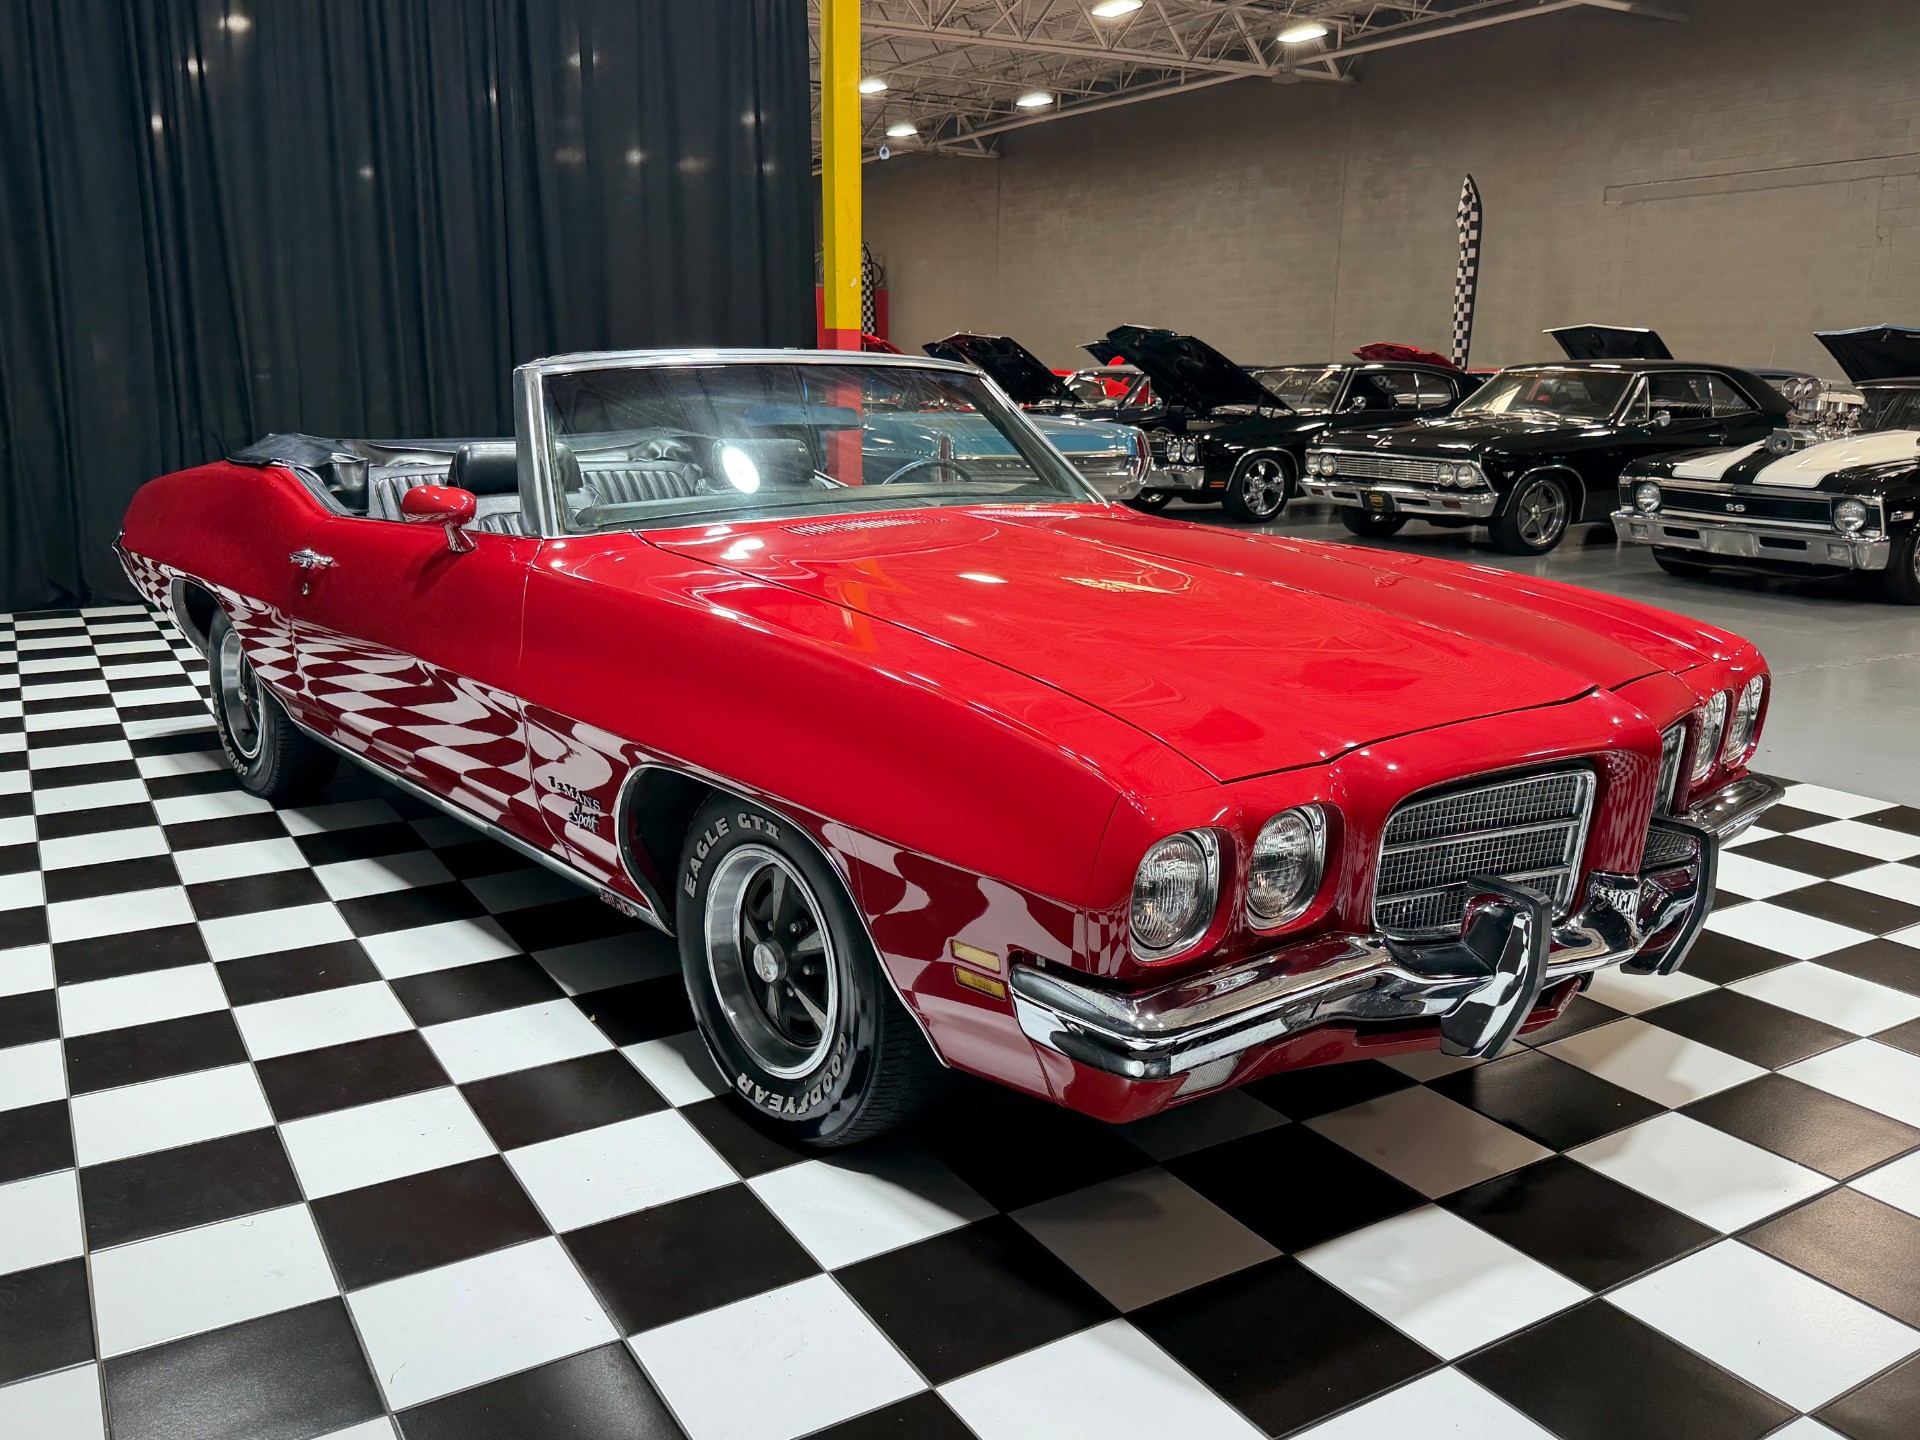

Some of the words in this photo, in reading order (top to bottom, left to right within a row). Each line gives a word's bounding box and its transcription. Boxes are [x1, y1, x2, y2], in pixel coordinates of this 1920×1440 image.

[996, 460, 1088, 469] BONNLE
[1725, 503, 1746, 513] SS
[684, 817, 730, 898] EAGLE
[737, 1032, 847, 1114] GOODYEAR
